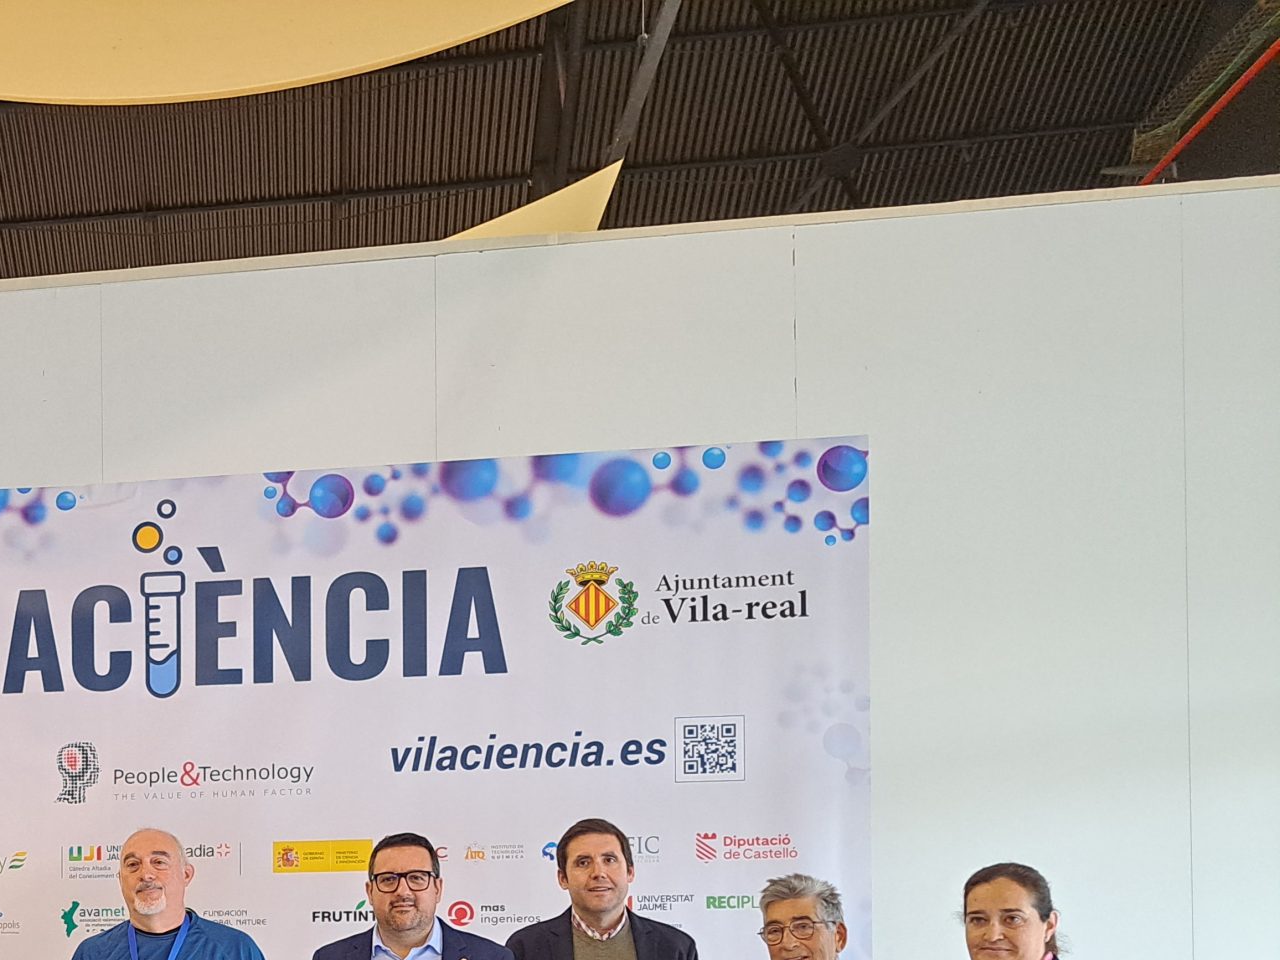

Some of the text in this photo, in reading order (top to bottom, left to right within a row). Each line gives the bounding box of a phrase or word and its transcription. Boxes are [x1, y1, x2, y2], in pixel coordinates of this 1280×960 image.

[655, 570, 795, 596] Ajuntament
[641, 589, 810, 625] de Vila-real
[390, 730, 668, 773] vilaciencia.es
[113, 761, 314, 787] People&Technology
[114, 788, 313, 800] THE VALUE OF HUMAN FACTOR
[723, 833, 791, 849] Diputació
[184, 843, 215, 858] adia
[723, 846, 798, 860] de Castelló
[637, 894, 695, 903] UNIVERSITAT
[706, 895, 761, 910] RECIPL
[80, 906, 125, 918] avamet
[203, 909, 248, 917] FUNDACIÓN
[480, 904, 506, 912] mas
[638, 902, 668, 911] JAUME
[236, 918, 268, 926] NATURE
[312, 910, 376, 923] FRUTINT
[480, 914, 541, 926] ingenieros
